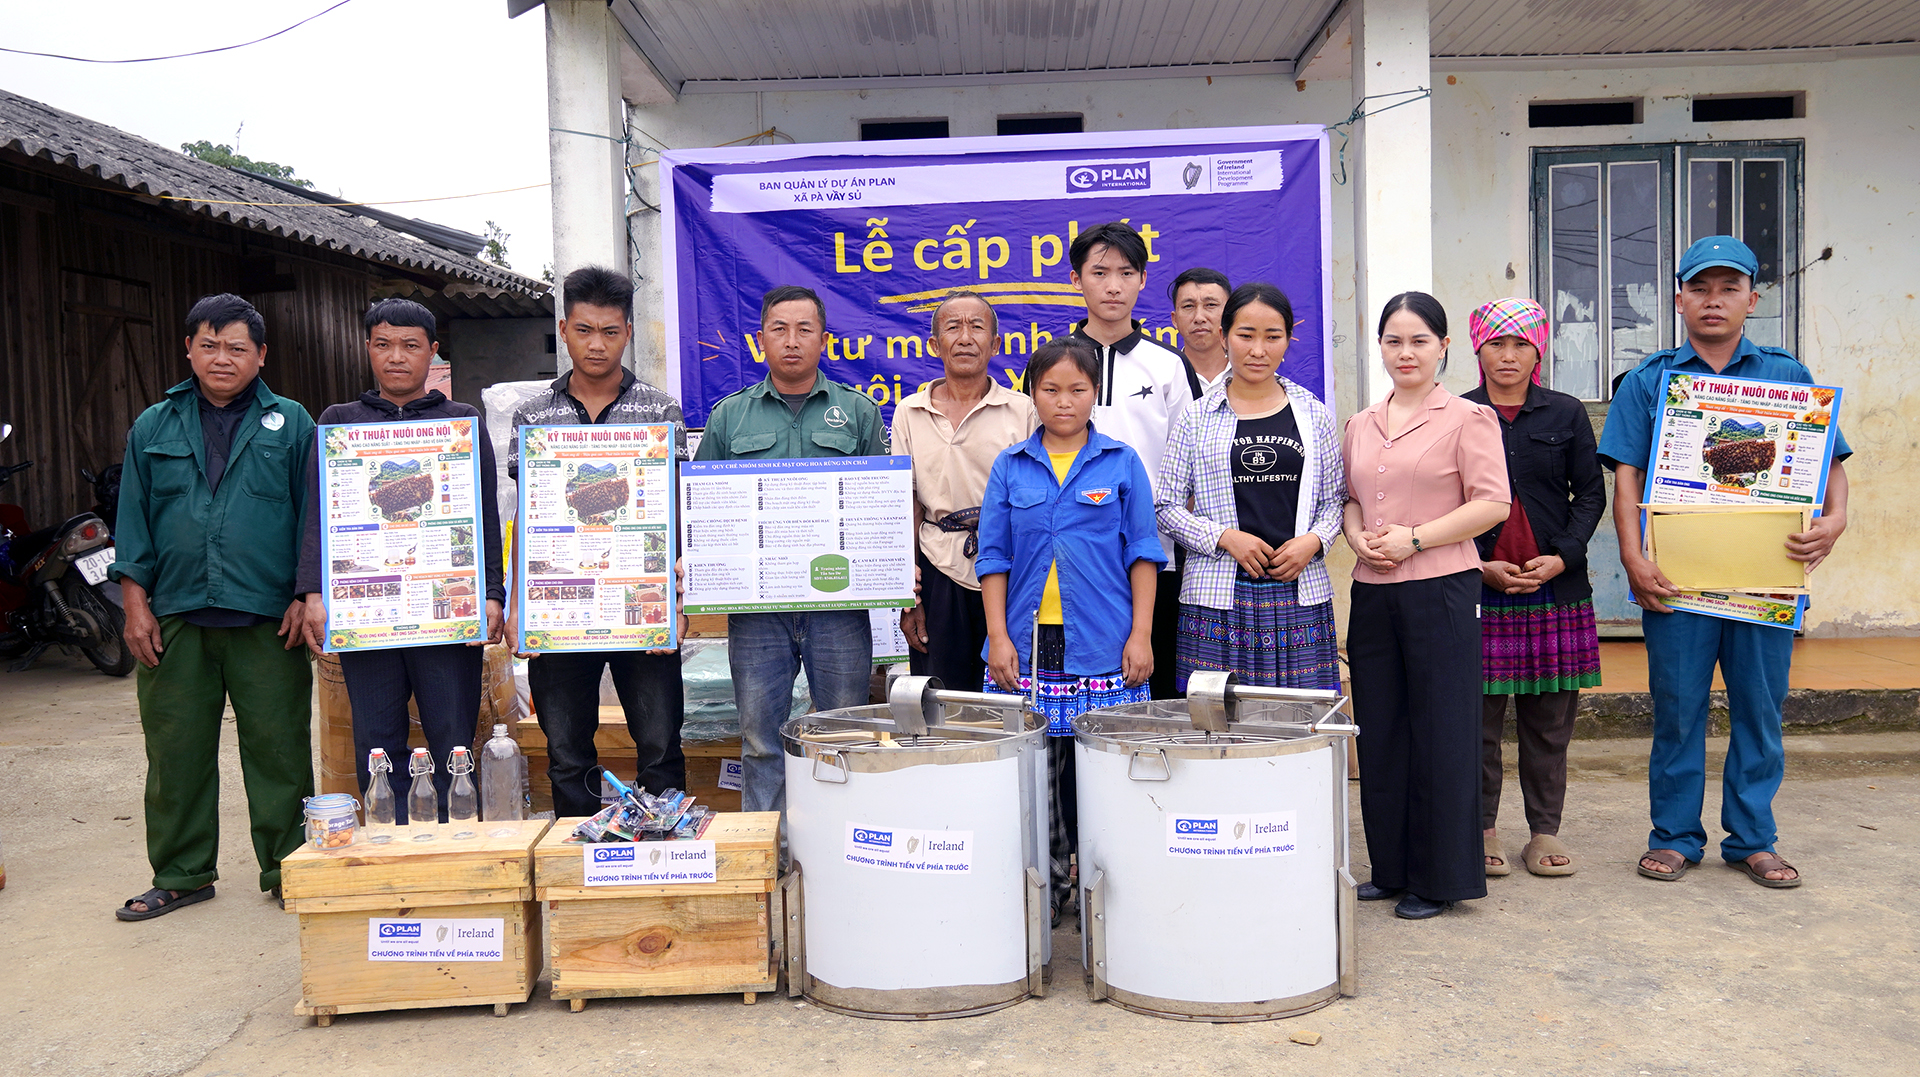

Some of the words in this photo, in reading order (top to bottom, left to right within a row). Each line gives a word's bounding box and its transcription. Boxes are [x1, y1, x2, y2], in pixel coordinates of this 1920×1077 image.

[1102, 168, 1147, 181] PLAN
[759, 182, 781, 191] BAN
[784, 178, 815, 191] QUẢN
[818, 178, 830, 189] LÝ
[831, 179, 848, 190] DỰ
[851, 177, 866, 188] ÁN
[869, 177, 896, 187] PLAN
[794, 192, 808, 202] XÃ
[811, 192, 824, 202] PÀ
[848, 189, 862, 200] SỦ
[834, 217, 894, 273] Lễ
[913, 218, 1010, 279] cấp
[1030, 217, 1161, 278] pt
[827, 332, 874, 361] tư
[887, 334, 943, 359] m
[995, 322, 1053, 355] nh
[1693, 380, 1706, 392] KỸ
[1709, 383, 1740, 397] THUẬT
[1742, 386, 1766, 398] NUÔI
[1768, 388, 1788, 400] ONG
[1791, 390, 1808, 404] NỘI
[348, 429, 360, 440] KỸ
[363, 428, 390, 441] THUẬT
[393, 427, 413, 438] NUÔI
[416, 427, 434, 437] ONG
[436, 424, 450, 438] NỘI
[548, 431, 559, 442] KỸ
[562, 430, 588, 443] THUẬT
[591, 430, 611, 441] NUÔI
[614, 432, 631, 441] ONG
[634, 429, 647, 442] NỘI
[1257, 474, 1298, 482] LIFESTYLE
[1255, 821, 1289, 834] Ireland
[869, 833, 890, 842] PLAN
[928, 841, 964, 851] Ireland
[1169, 846, 1201, 854] CHƯƠNG
[1227, 846, 1242, 855] TIẾN
[1272, 844, 1294, 852] TRƯỚC
[671, 850, 706, 860] Ireland
[846, 854, 875, 864] CHƯƠNG
[876, 859, 897, 868] TRÌNH
[899, 860, 914, 869] TIẾN
[644, 872, 659, 880] TIẾN
[458, 928, 494, 938] Ireland
[429, 949, 444, 957] TIẾN
